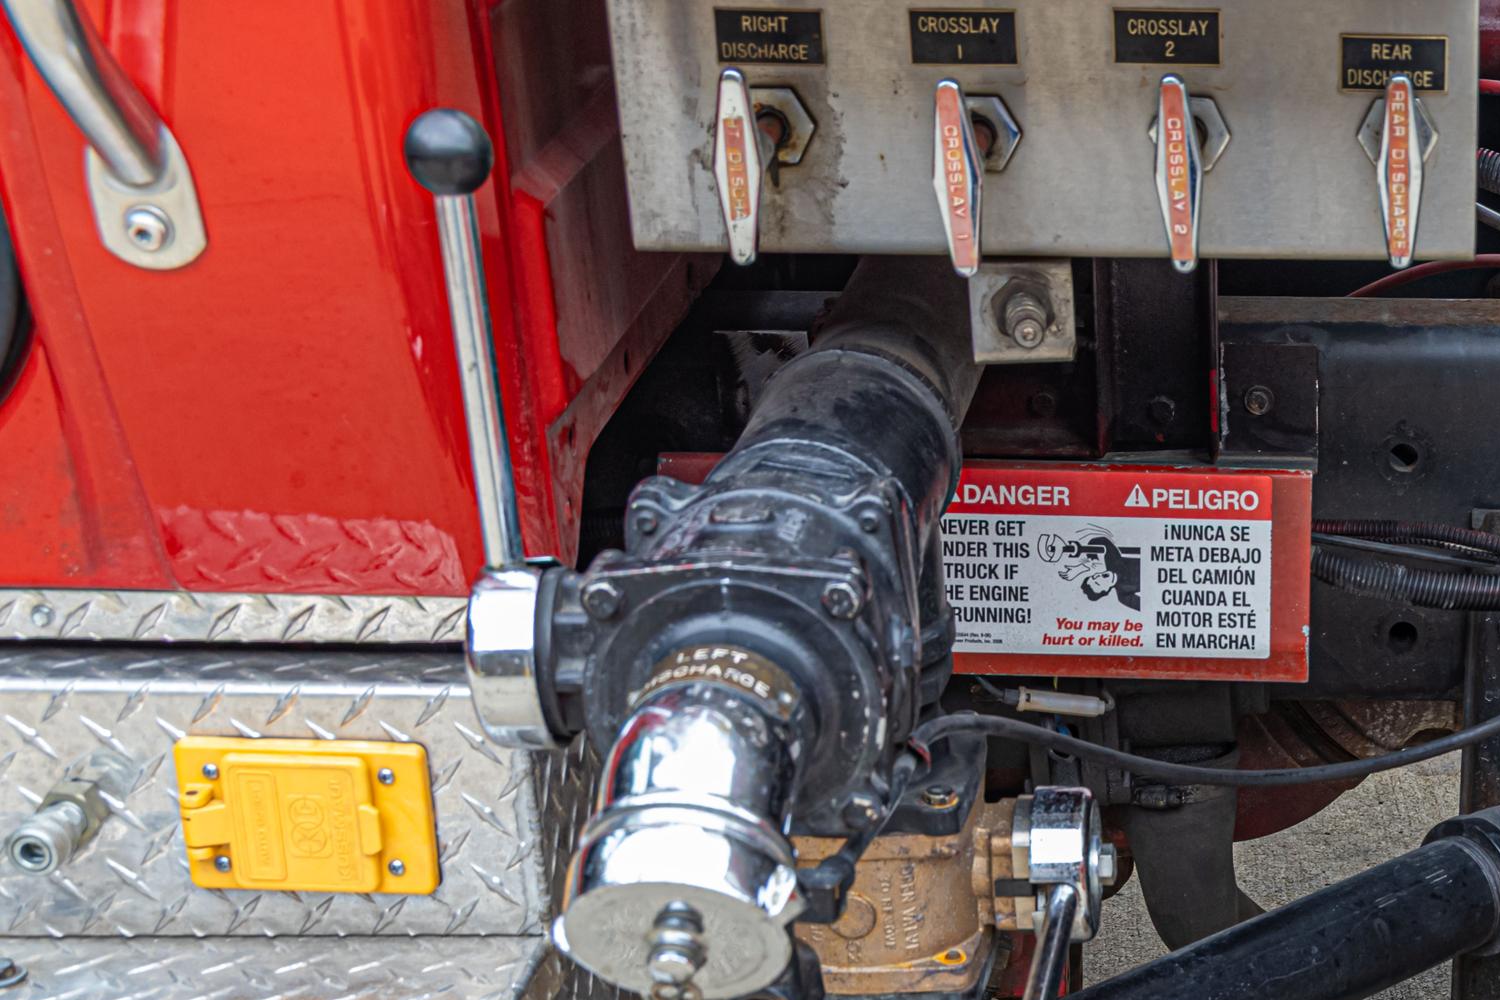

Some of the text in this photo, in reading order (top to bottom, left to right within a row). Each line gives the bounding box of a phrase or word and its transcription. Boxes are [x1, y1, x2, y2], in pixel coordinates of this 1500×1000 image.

[741, 15, 788, 33] RIGHT
[918, 16, 1000, 34] CROSSLAY
[1127, 20, 1208, 37] CROSSLAY
[721, 41, 808, 60] DISCHARGE
[1164, 42, 1175, 58] 2
[1371, 43, 1412, 61] REAR
[1347, 69, 1434, 88] DISCHGE
[1391, 90, 1406, 137] REAR
[944, 124, 966, 218] CROSSLAY
[1167, 118, 1188, 235] CROSSLAY 2
[963, 484, 1071, 506] DANGER
[1152, 488, 1259, 511] PELIGRO
[940, 519, 1026, 536] NEVER GET
[1164, 524, 1250, 542] ¡NUNCA SE
[943, 541, 1030, 559] NDER THIS
[1151, 546, 1261, 564] META DEBAJO
[944, 563, 1019, 580] TRUCK IF
[1158, 566, 1255, 585] DEL CAMIÓN
[945, 585, 1029, 602] HE ENGINE
[1161, 589, 1251, 607] CUANDA EL
[1056, 617, 1143, 633] You may be
[1156, 609, 1256, 629] MOTOR ESTÉ
[1042, 633, 1144, 647] hurt or killed.
[1156, 633, 1255, 650] EN MARCHA!
[676, 648, 749, 664] LEFT
[644, 664, 770, 698] ISCHARGE
